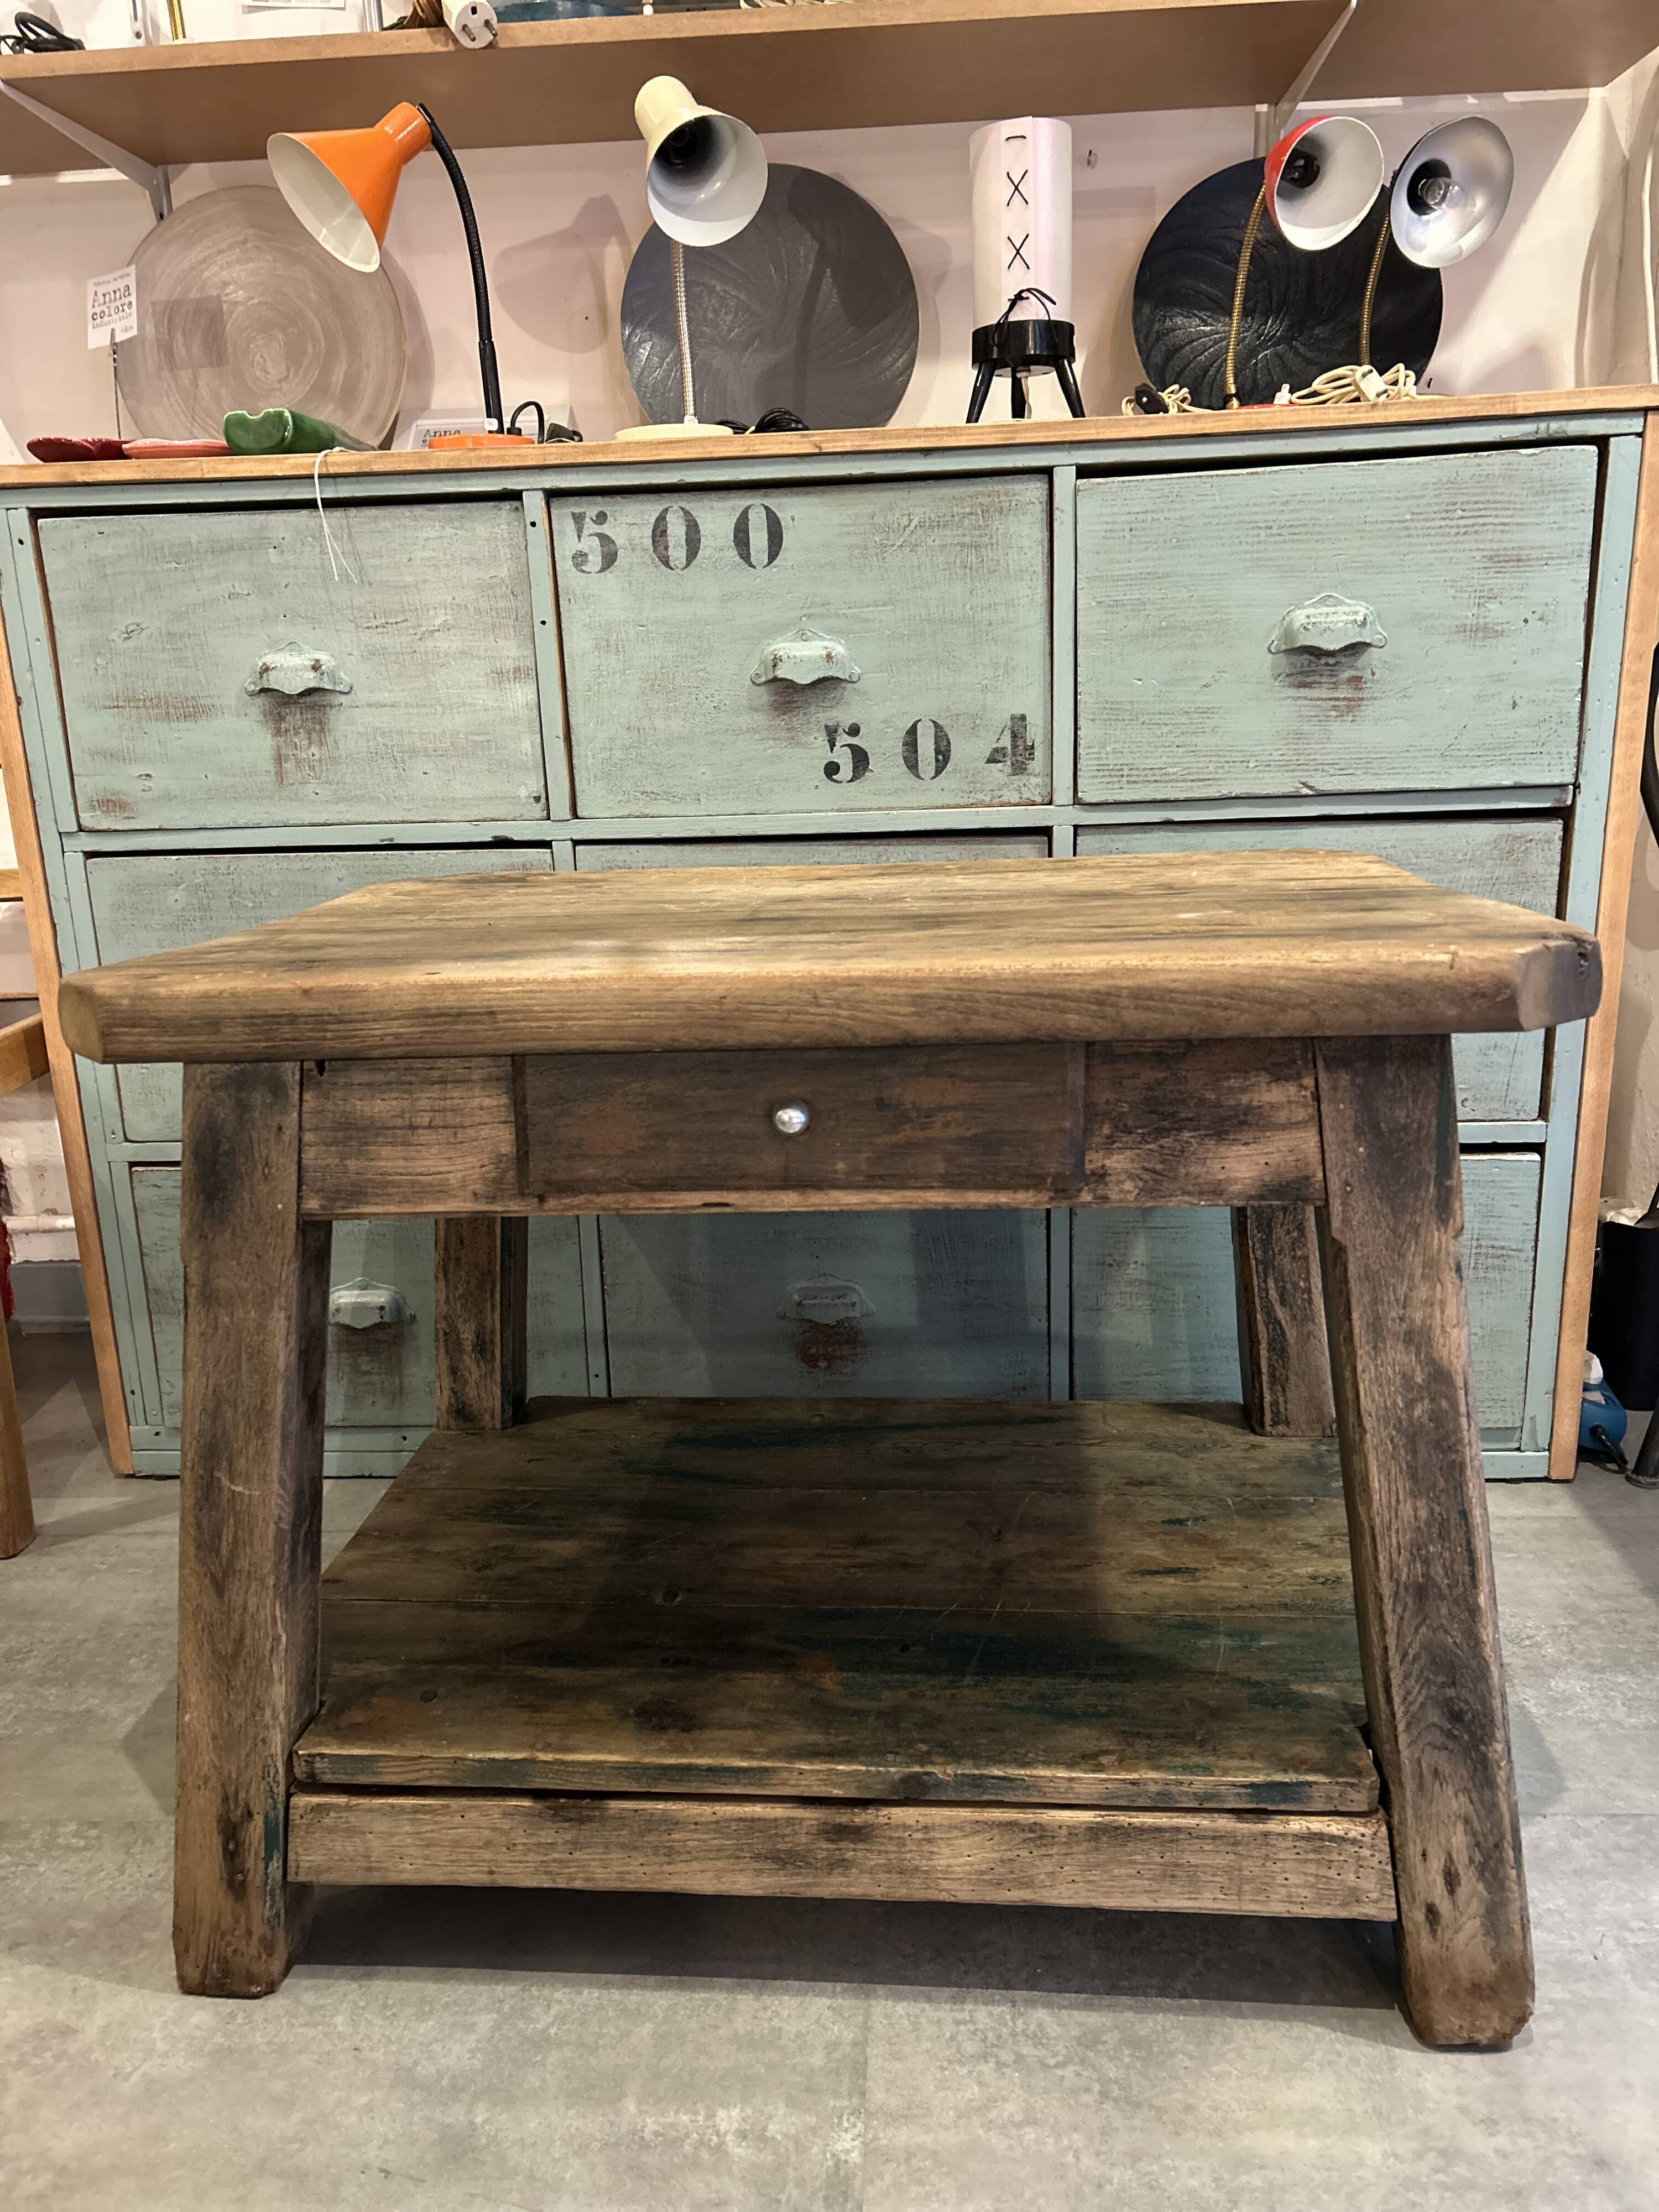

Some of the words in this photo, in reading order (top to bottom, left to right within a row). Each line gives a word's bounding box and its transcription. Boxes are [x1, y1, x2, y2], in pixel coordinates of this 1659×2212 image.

[91, 300, 132, 321] colore
[92, 284, 132, 308] Anna
[571, 503, 784, 574] 500
[823, 713, 1036, 784] 504
